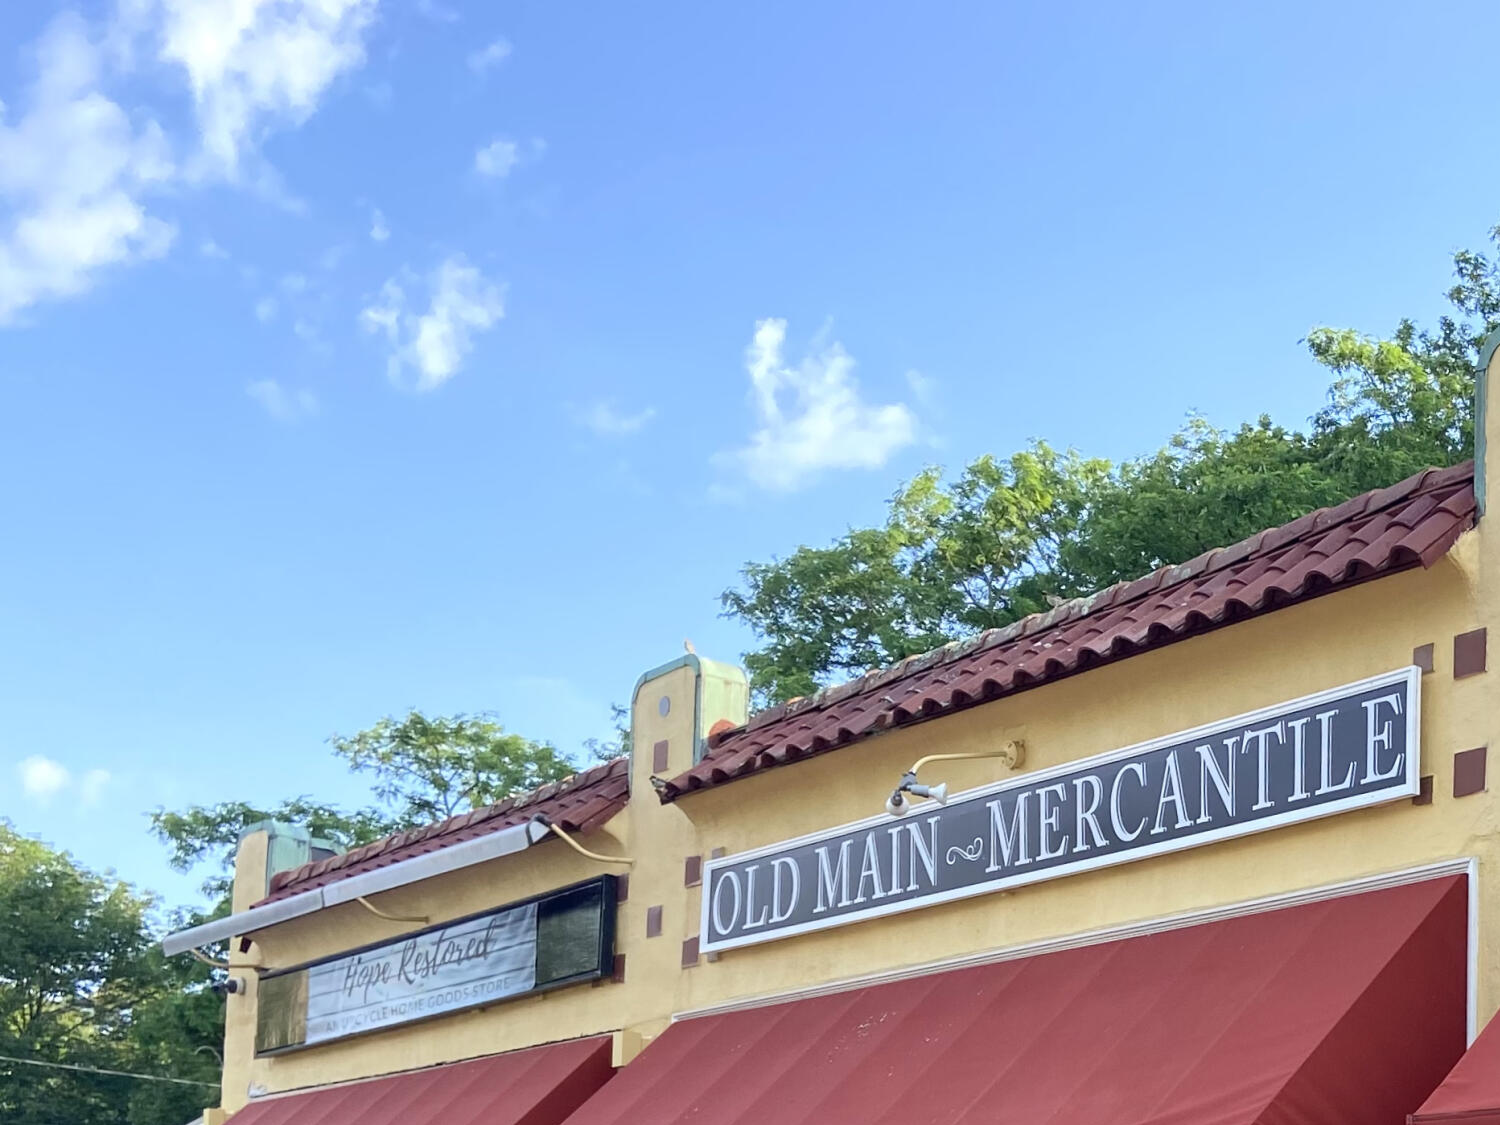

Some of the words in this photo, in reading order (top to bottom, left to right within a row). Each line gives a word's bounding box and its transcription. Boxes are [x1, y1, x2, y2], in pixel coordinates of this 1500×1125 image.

[711, 856, 800, 937] OLD
[812, 815, 941, 914] MAIN
[984, 691, 1405, 873] MERCANTILE
[343, 955, 391, 1004] Hope
[397, 918, 497, 985] Restored
[390, 998, 425, 1017] HOME
[427, 986, 470, 1009] GOODS
[471, 976, 512, 998] STORE
